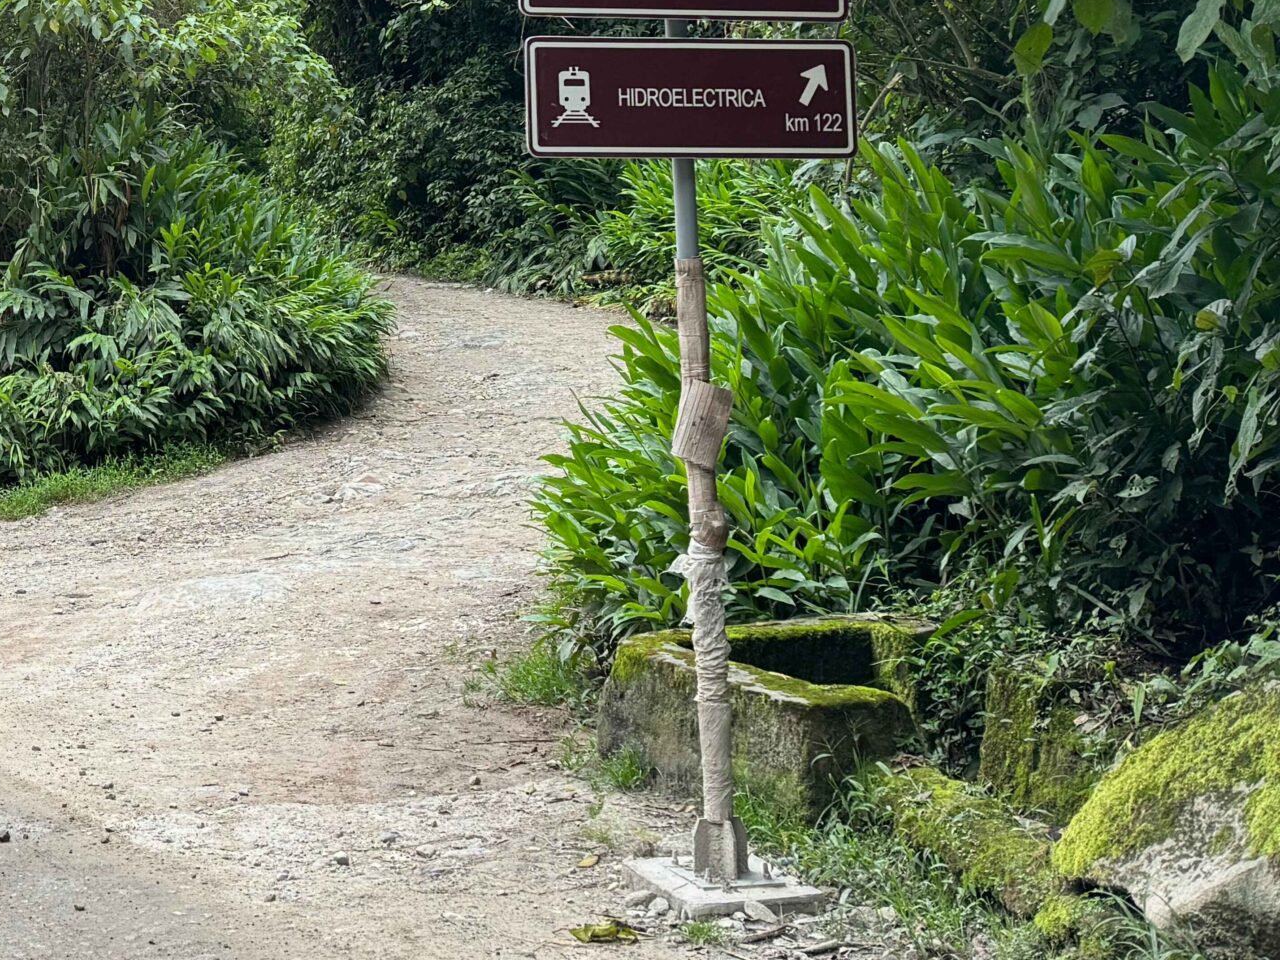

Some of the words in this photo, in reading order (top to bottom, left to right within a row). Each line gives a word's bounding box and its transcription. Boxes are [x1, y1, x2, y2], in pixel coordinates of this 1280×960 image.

[618, 87, 767, 108] HIDROELECTRICA
[785, 113, 809, 132] km
[814, 114, 843, 132] 122
